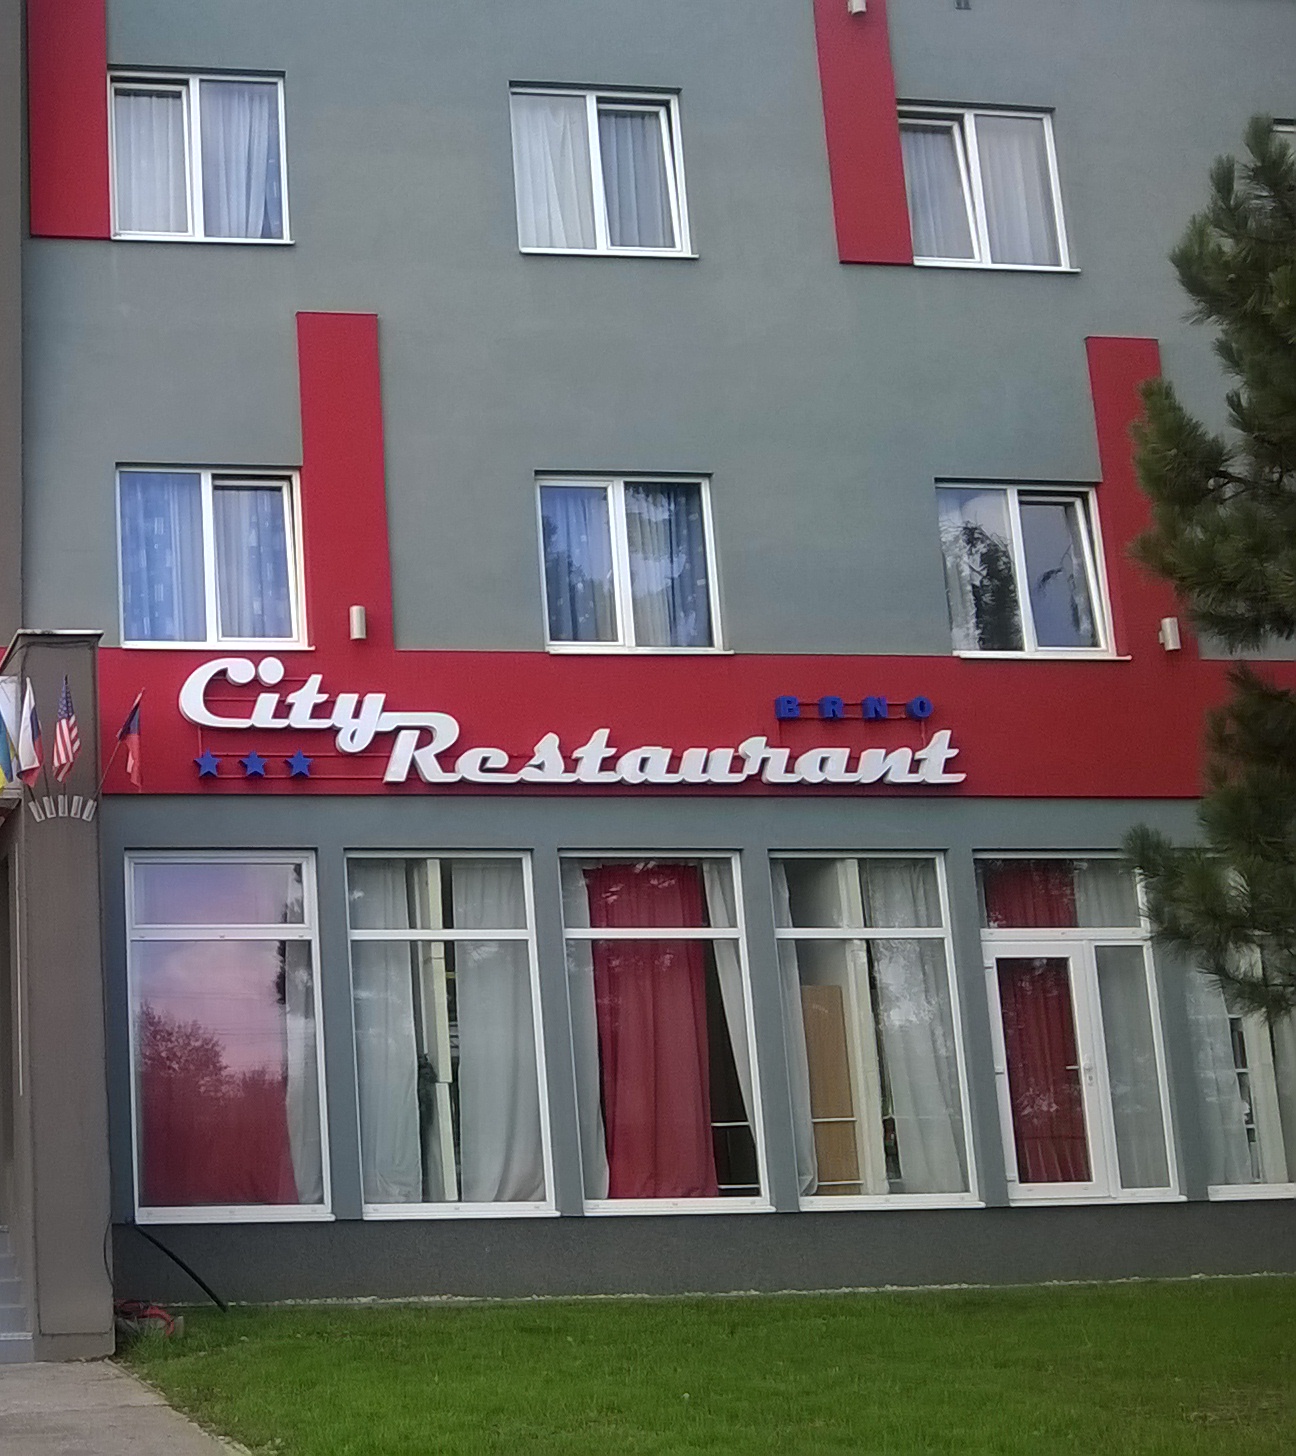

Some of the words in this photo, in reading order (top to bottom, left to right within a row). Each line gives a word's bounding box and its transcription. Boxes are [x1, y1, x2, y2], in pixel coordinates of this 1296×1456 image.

[178, 656, 387, 754] City
[775, 695, 933, 719] BRNO
[381, 711, 967, 784] Restaurant
